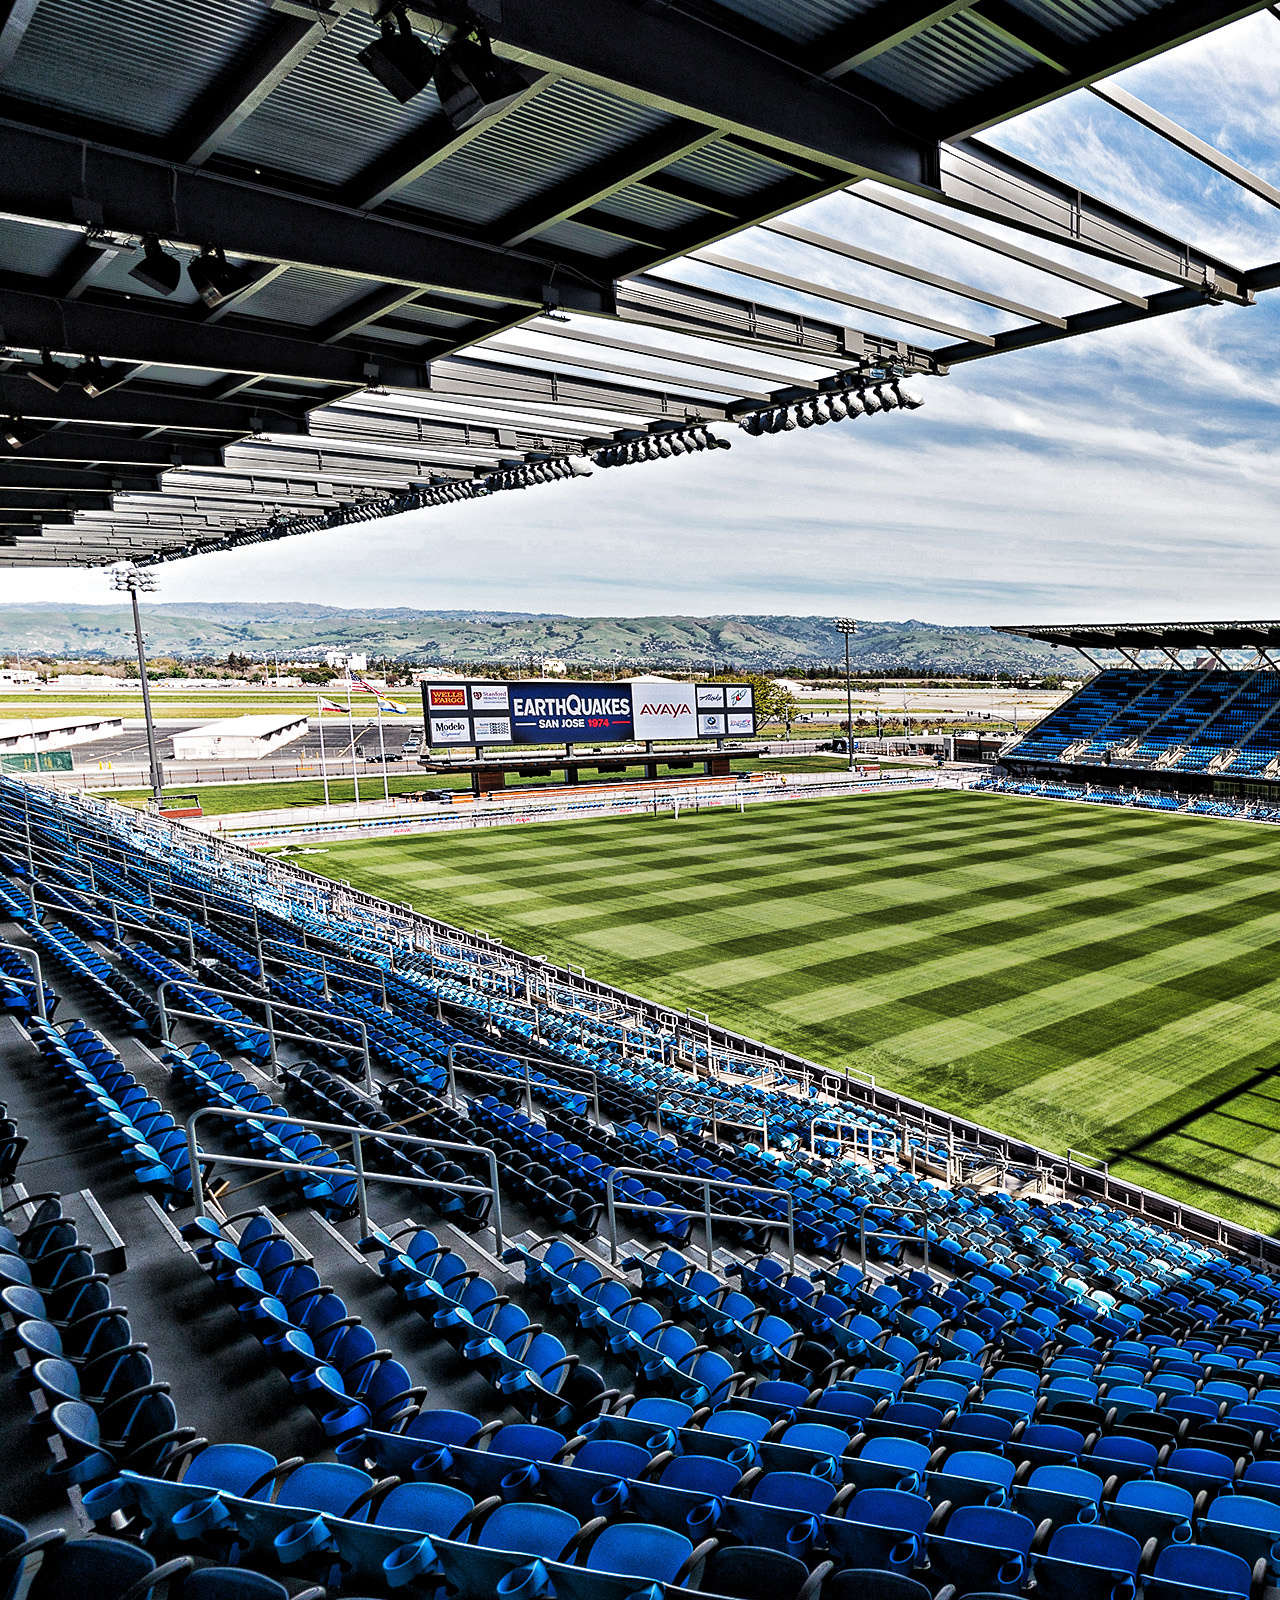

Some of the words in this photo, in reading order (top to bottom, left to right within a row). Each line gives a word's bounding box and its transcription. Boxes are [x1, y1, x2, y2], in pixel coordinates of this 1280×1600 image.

[513, 694, 630, 716] EARTHQUAKES
[640, 704, 692, 718] AVAYA
[435, 723, 466, 731] Modelo
[539, 719, 559, 728] SAN
[561, 719, 585, 728] JOSE
[588, 719, 609, 727] 1974
